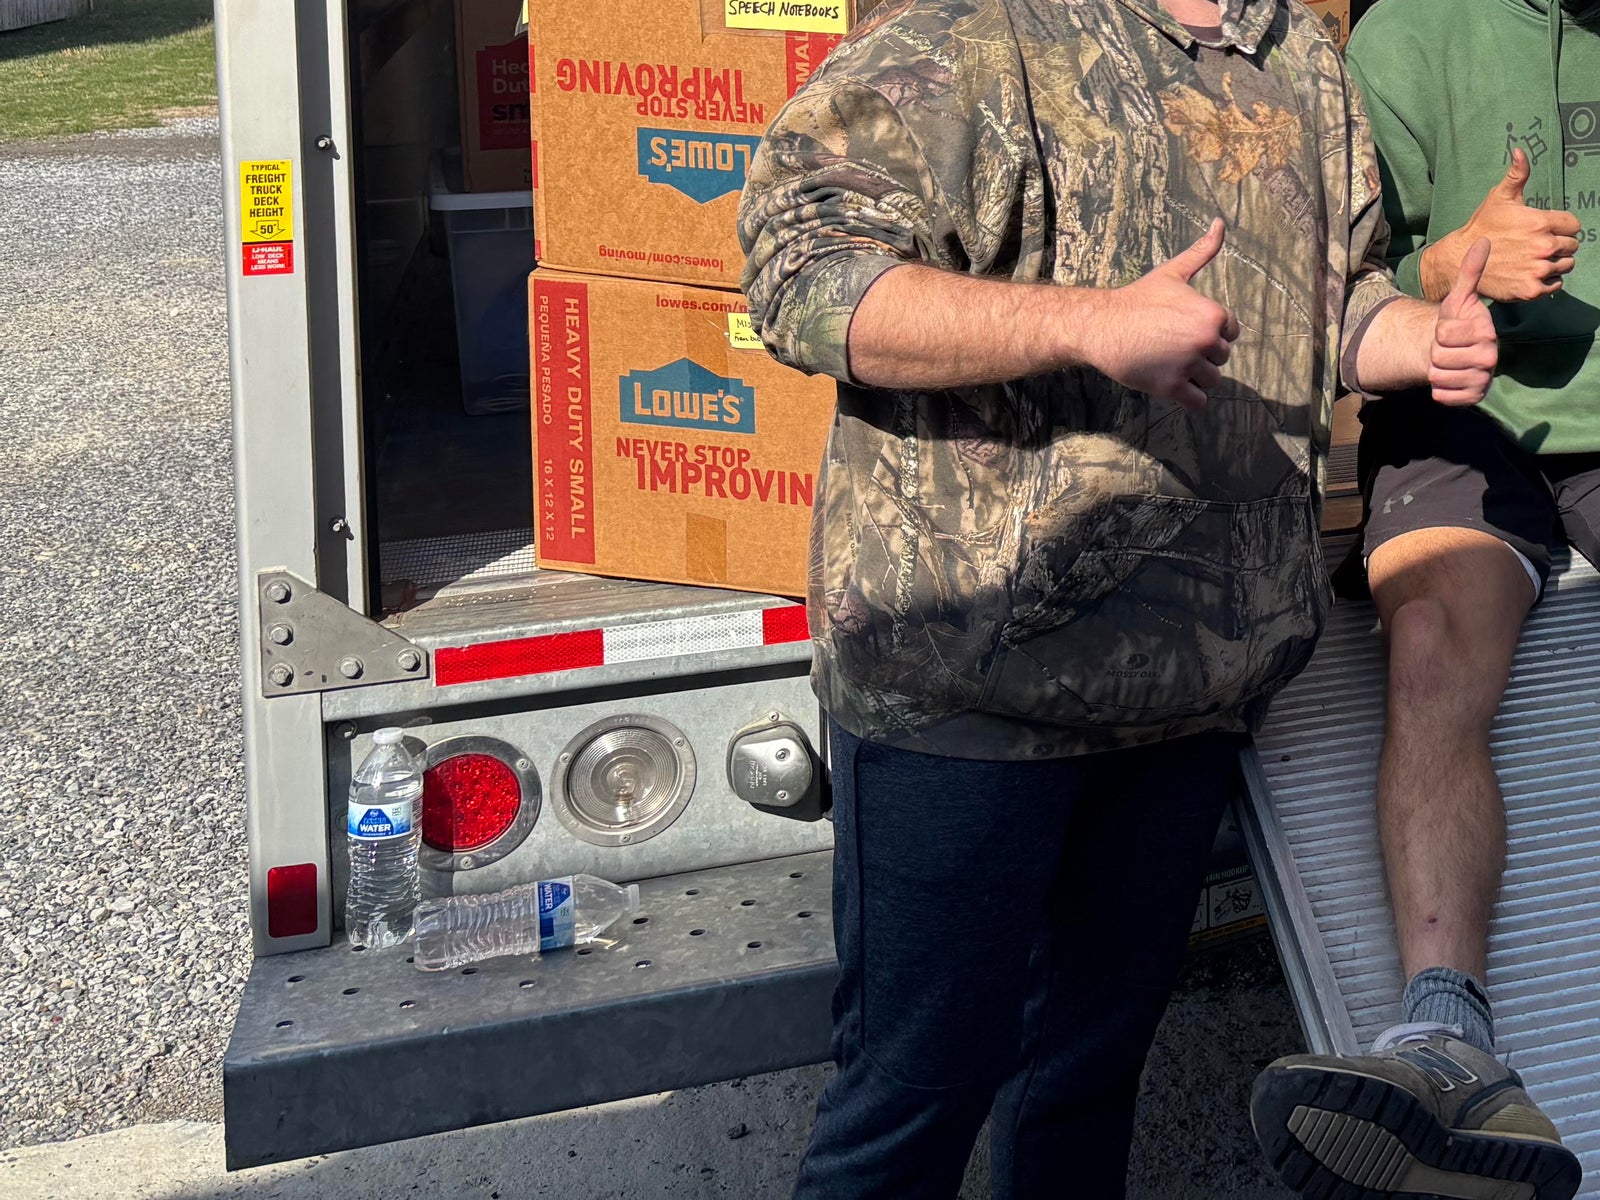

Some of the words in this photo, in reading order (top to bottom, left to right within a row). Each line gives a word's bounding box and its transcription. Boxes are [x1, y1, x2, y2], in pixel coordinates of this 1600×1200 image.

[728, 0, 775, 16] SPEECH
[779, 1, 840, 19] NOTEBOOKS
[492, 59, 529, 76] Hea
[795, 32, 810, 93] MAL
[492, 78, 530, 94] Dut
[556, 58, 744, 103] IMPROVING
[636, 96, 689, 118] STOP
[694, 99, 764, 125] NEVER
[650, 137, 751, 178] LOWE'S
[245, 173, 286, 184] FREIGHT
[250, 185, 282, 195] TRUCK
[249, 207, 284, 218] HEIGHT
[253, 196, 280, 206] DECK
[599, 245, 724, 272] lowes.com/moving
[539, 295, 551, 364] PEQUEÑA
[564, 297, 582, 379] HEAVY
[541, 367, 552, 425] PESADO
[634, 382, 741, 425] LOWE'S
[567, 387, 584, 452] DUTY
[616, 437, 688, 463] NEVER
[694, 444, 751, 468] STOP
[544, 459, 553, 475] 16
[545, 478, 554, 487] X
[637, 454, 813, 507] IMPROVIN
[545, 491, 554, 507] 12
[569, 458, 586, 540] SMALL
[545, 512, 554, 521] X
[545, 525, 555, 541] 12
[359, 823, 391, 833] WATER
[543, 882, 553, 910] WATER
